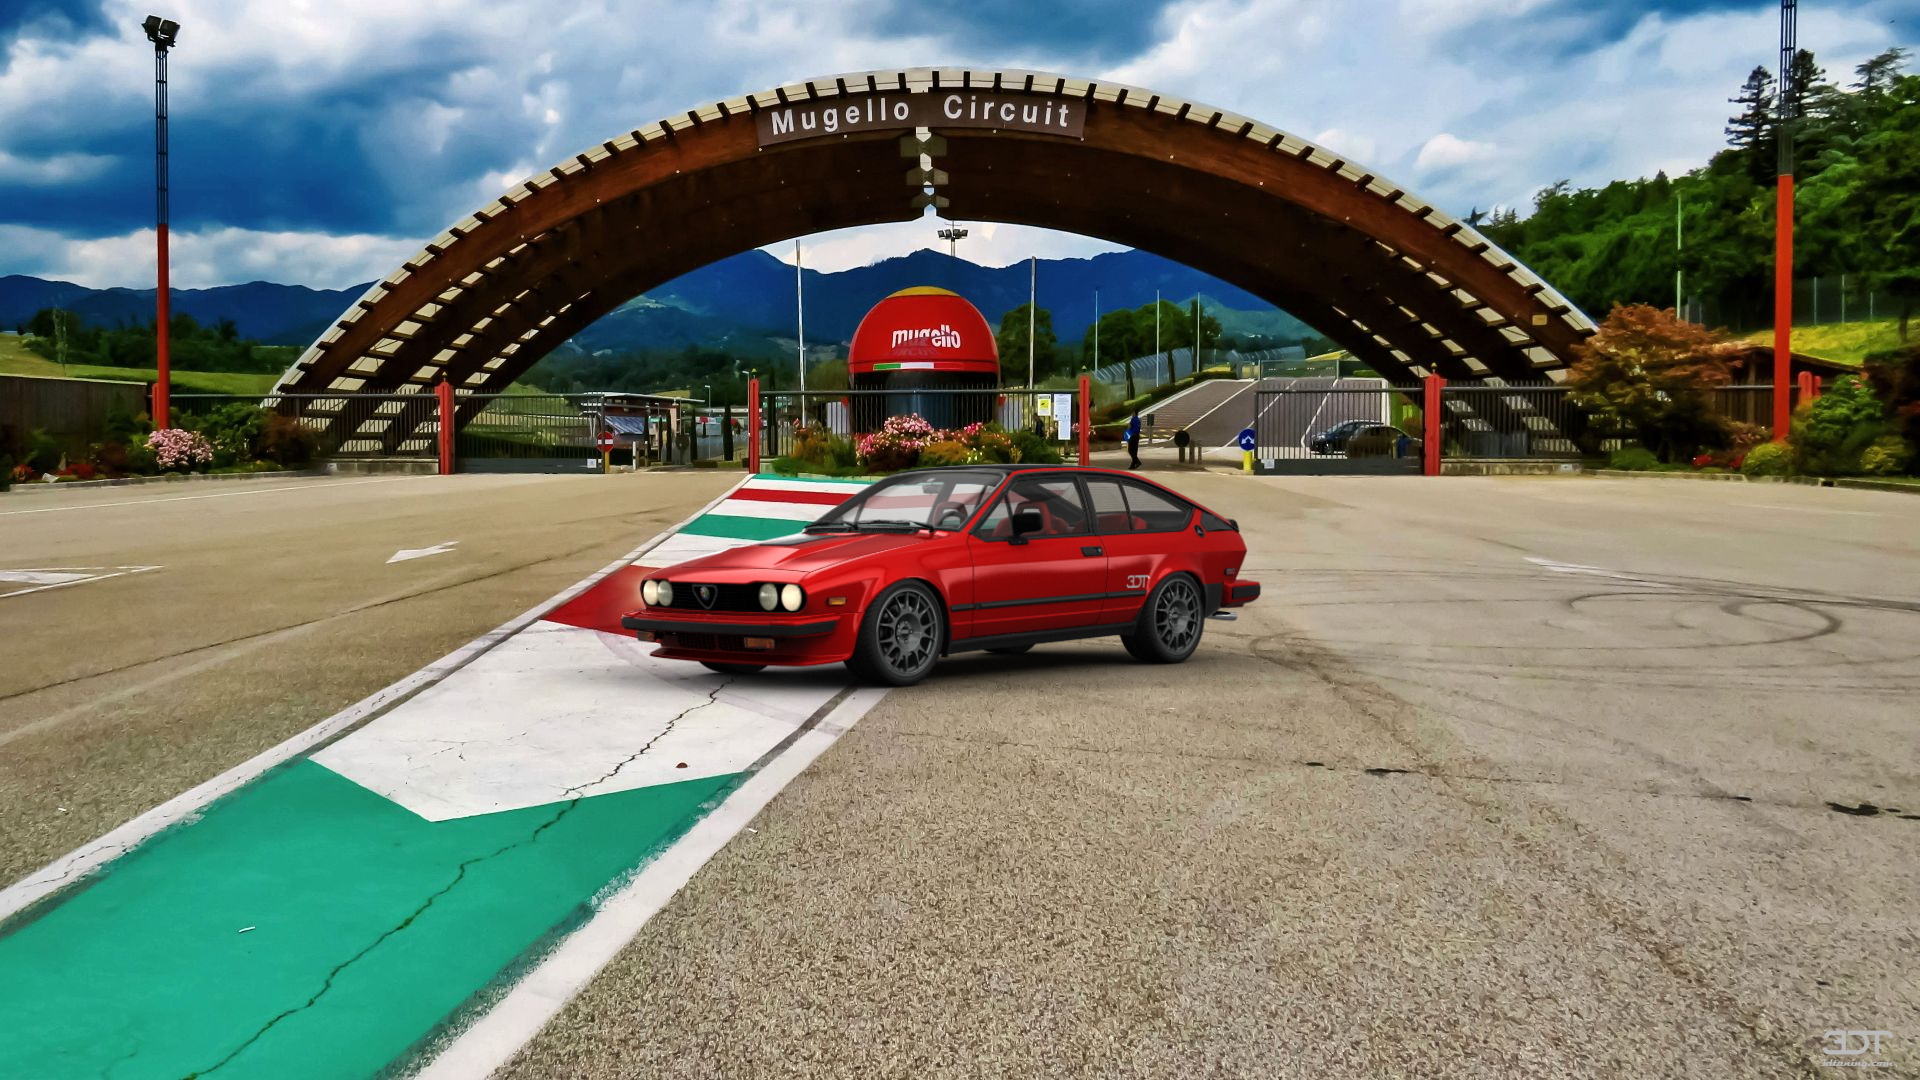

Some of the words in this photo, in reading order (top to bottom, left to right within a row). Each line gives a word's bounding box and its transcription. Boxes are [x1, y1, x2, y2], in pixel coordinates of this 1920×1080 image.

[771, 98, 909, 135] Mugello
[943, 94, 1069, 128] Circuit
[891, 324, 961, 349] mugello
[1126, 574, 1150, 588] 3DT
